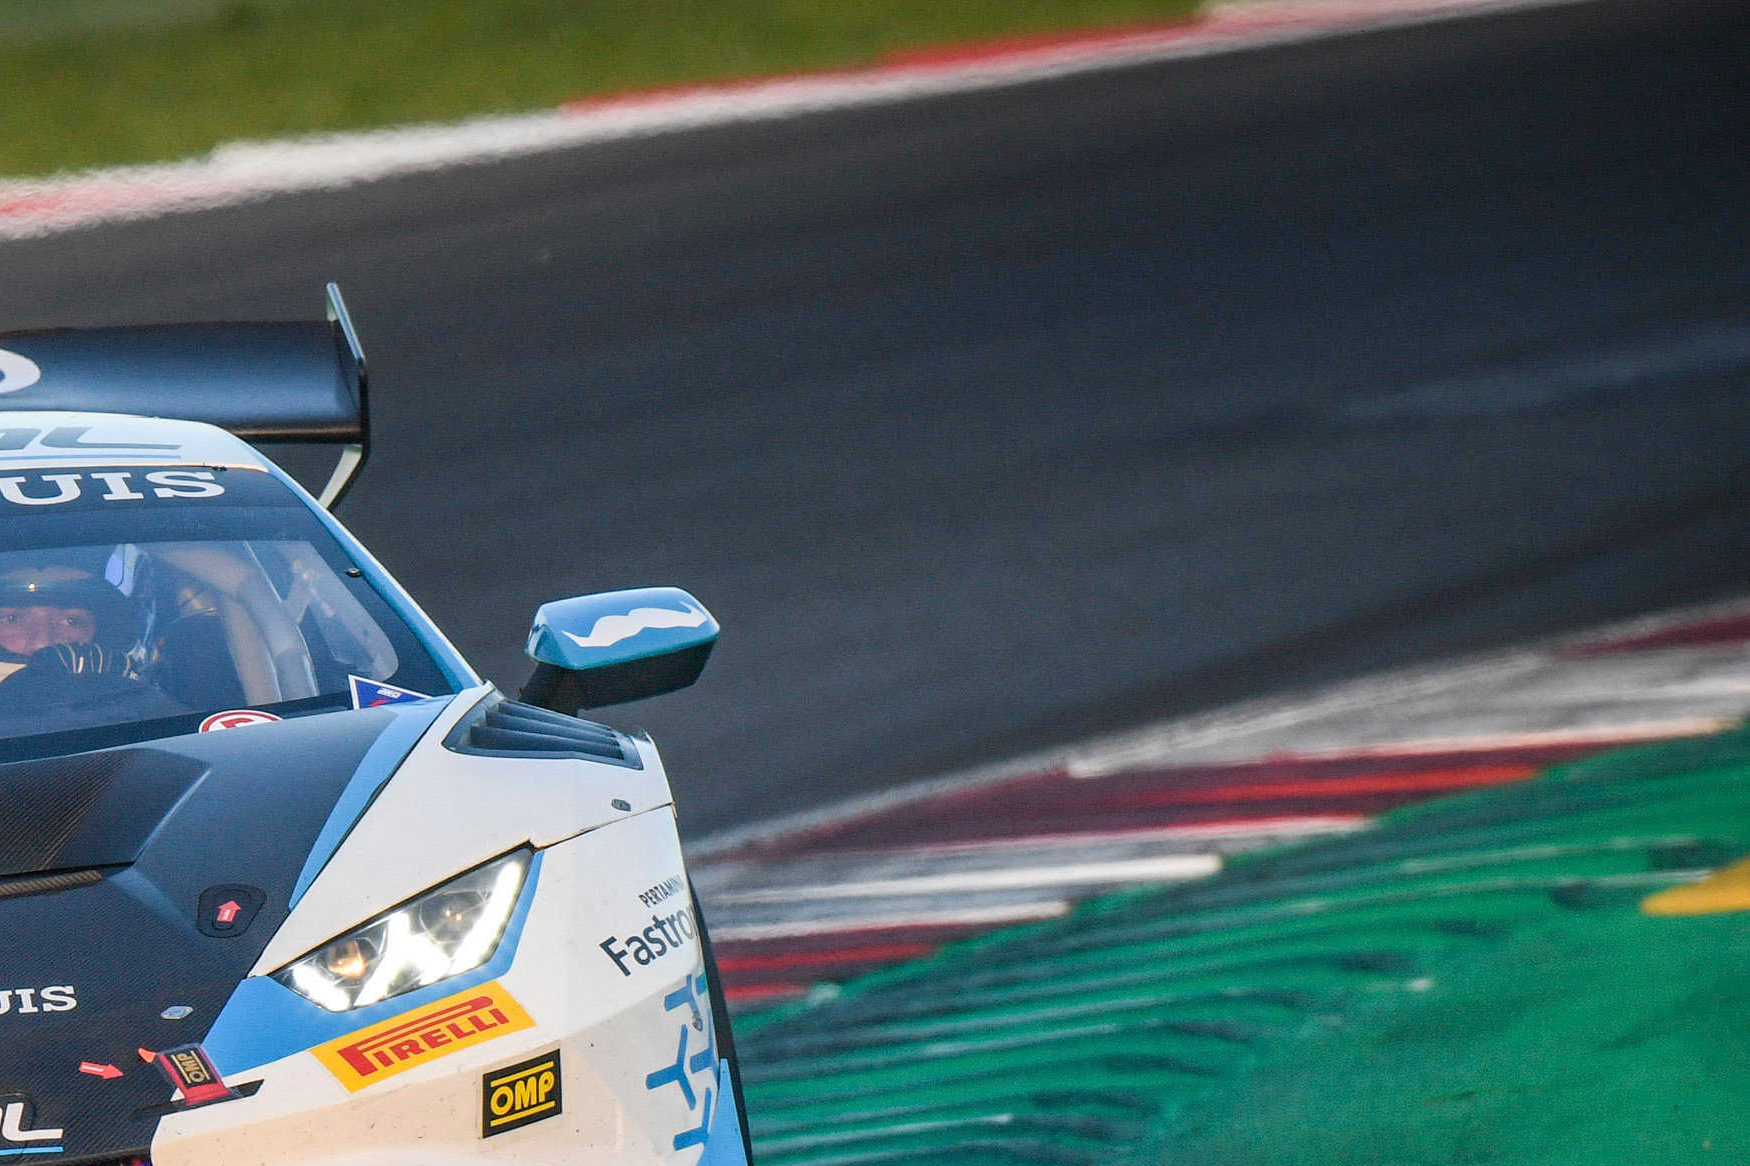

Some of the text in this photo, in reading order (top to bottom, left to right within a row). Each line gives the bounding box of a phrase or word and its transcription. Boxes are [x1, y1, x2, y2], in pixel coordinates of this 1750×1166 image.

[599, 903, 698, 977] Fastro
[337, 995, 510, 1077] PIRELLI
[176, 1053, 205, 1083] OMP
[490, 1071, 555, 1116] OMP
